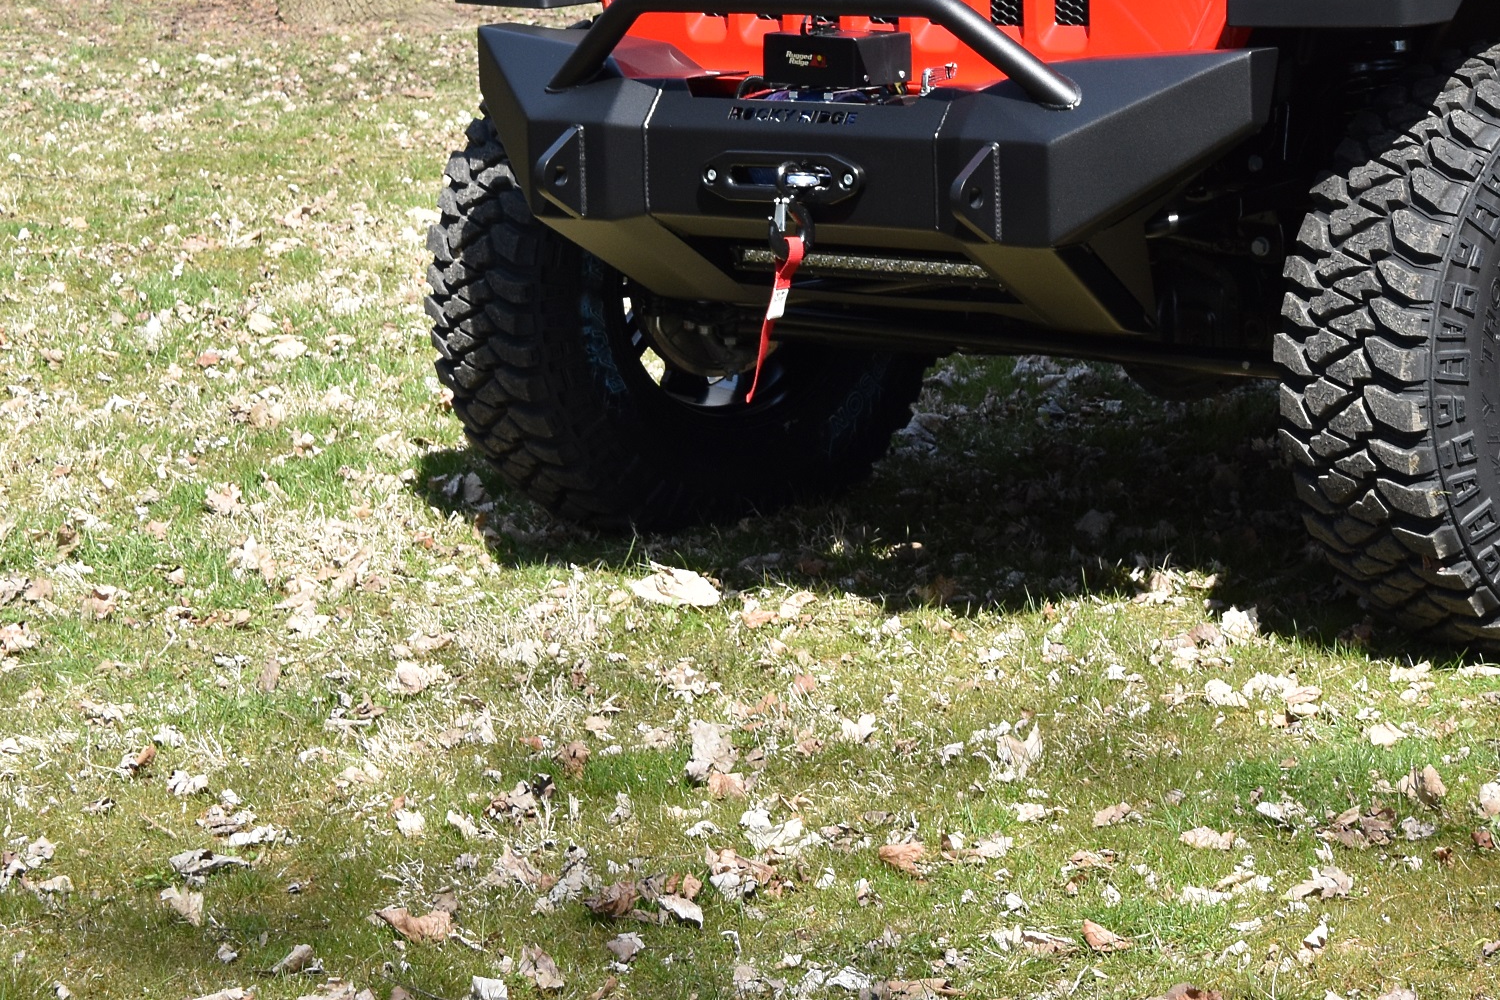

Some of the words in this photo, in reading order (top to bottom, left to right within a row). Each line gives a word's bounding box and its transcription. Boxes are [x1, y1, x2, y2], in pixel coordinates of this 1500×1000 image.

[785, 50, 813, 61] Rugged
[788, 57, 810, 67] Ridge
[727, 106, 796, 122] ROCKY
[797, 110, 858, 125] RIDGE
